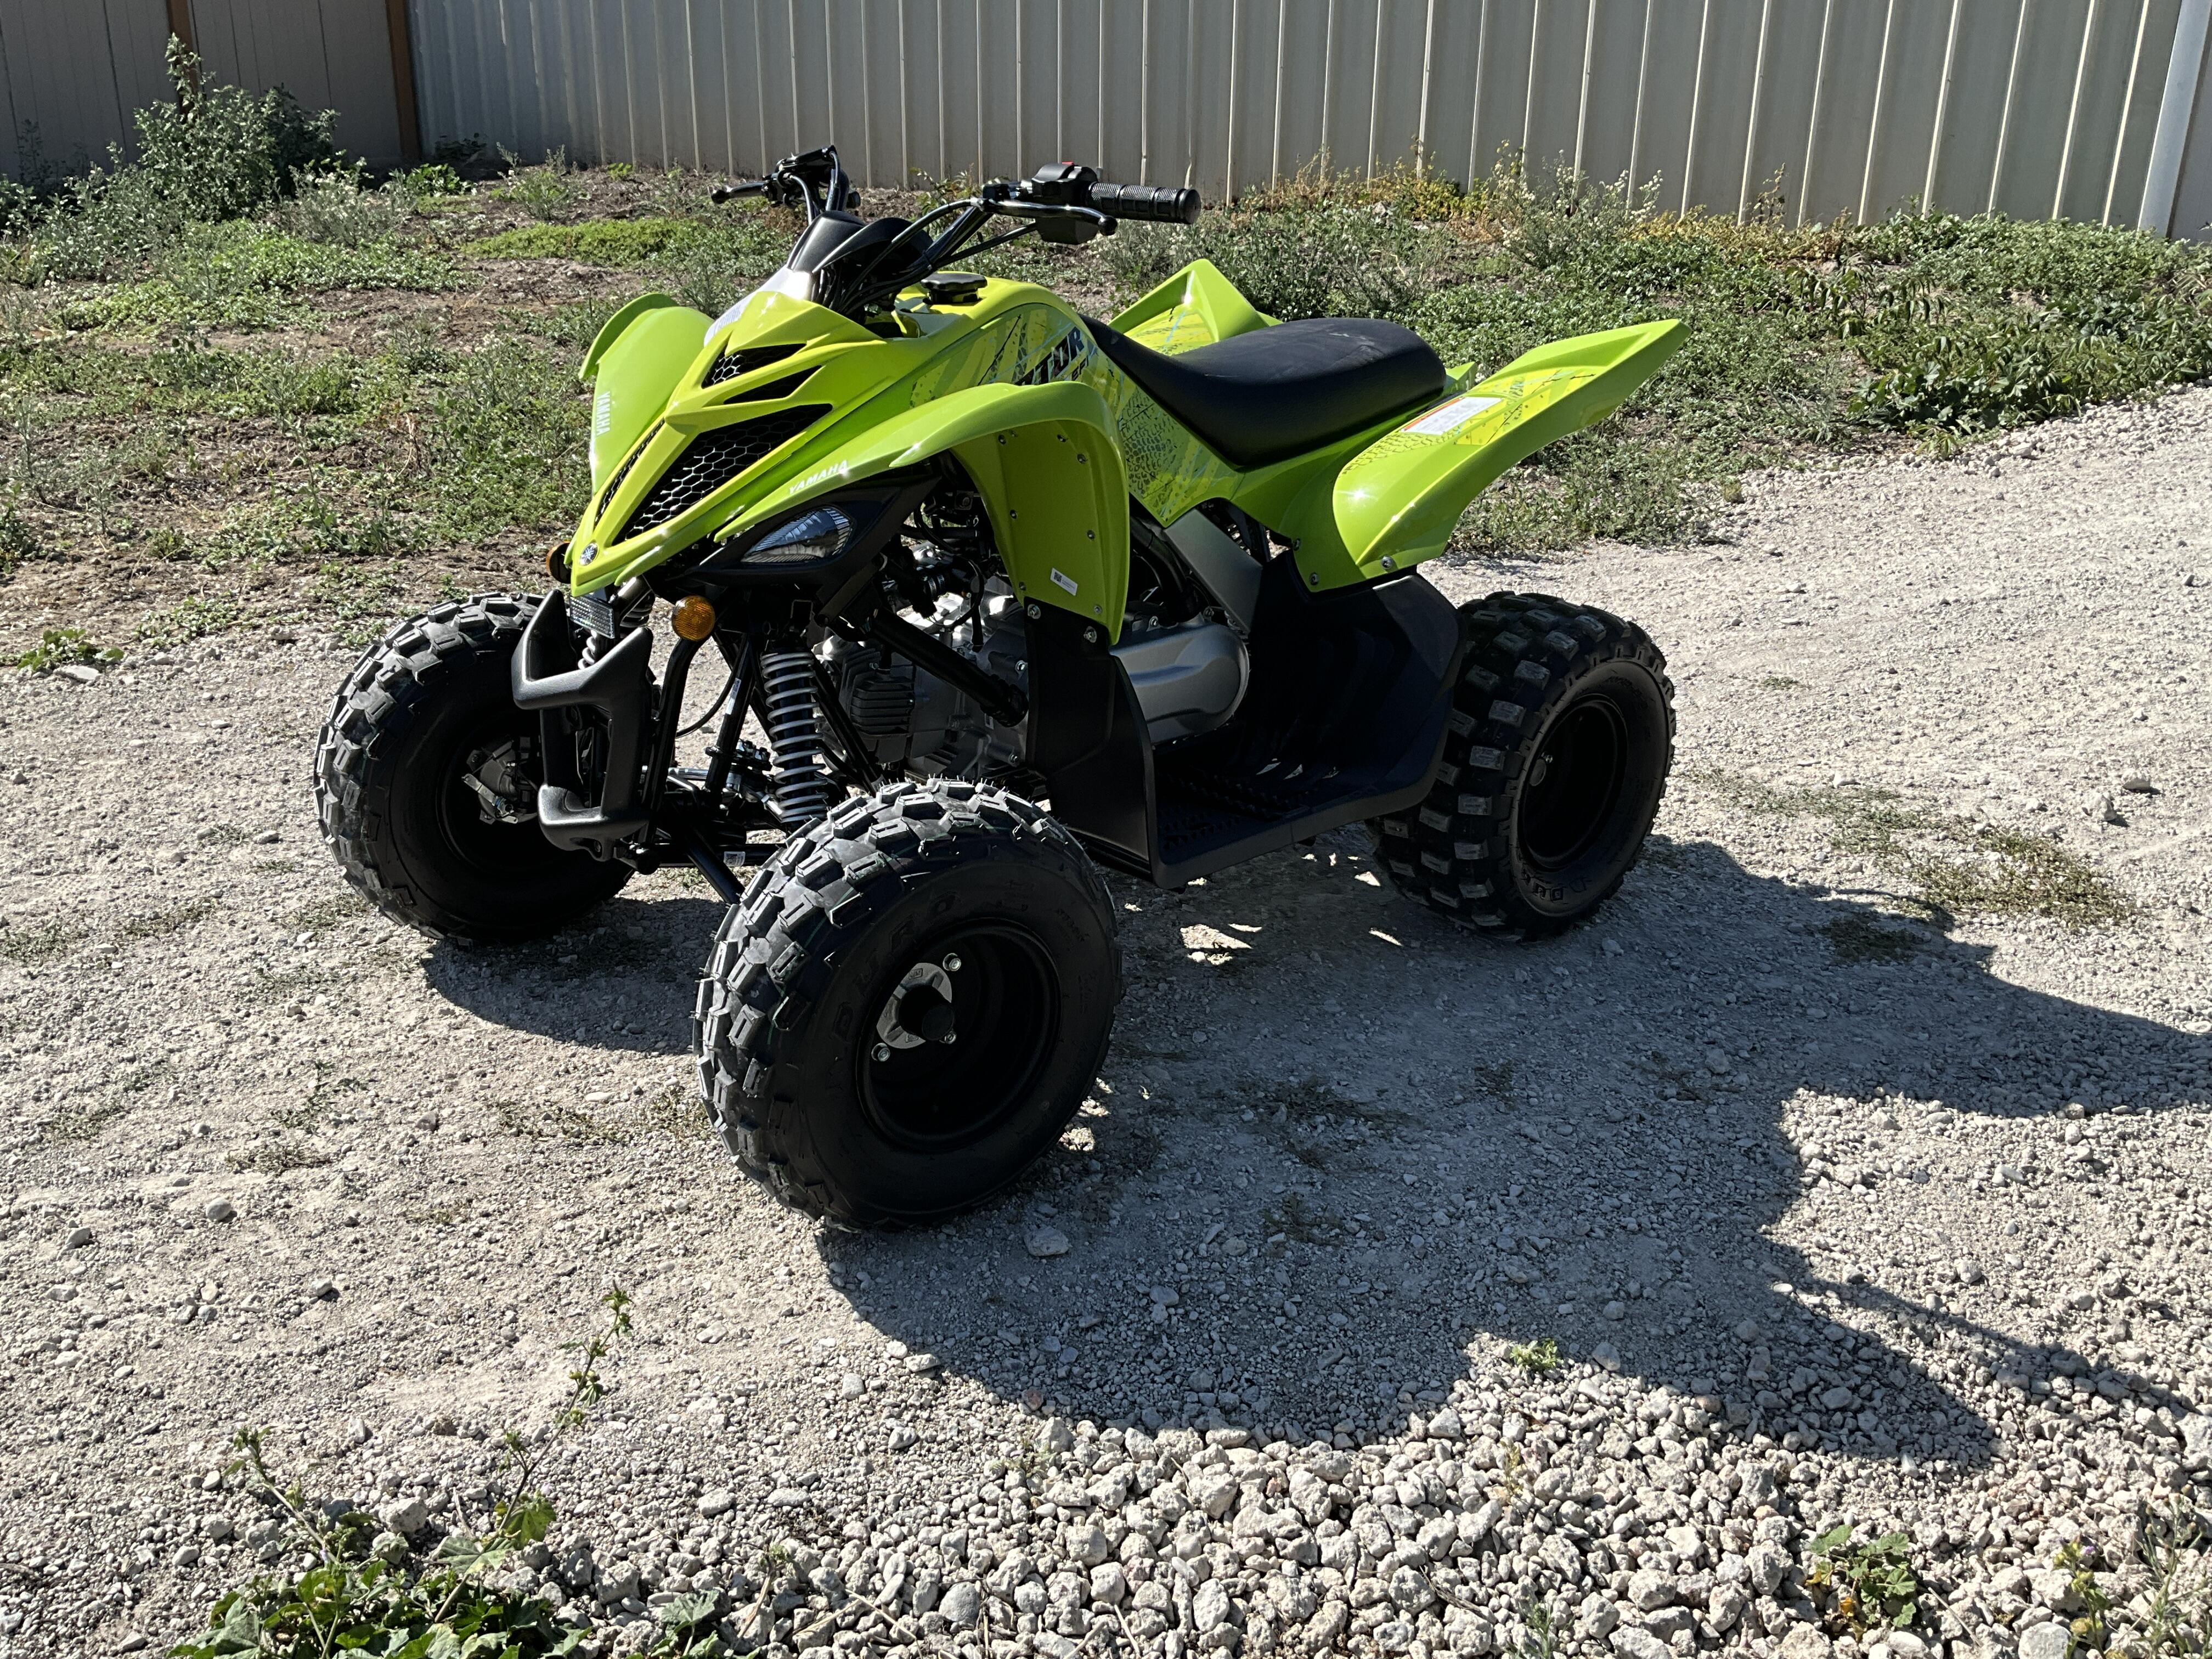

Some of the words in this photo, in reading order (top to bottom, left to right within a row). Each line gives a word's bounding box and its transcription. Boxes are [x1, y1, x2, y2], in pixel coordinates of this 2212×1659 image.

[1071, 354, 1090, 381] EFI
[596, 391, 611, 437] YAMAHA
[789, 459, 848, 495] YAMAHA
[833, 891, 959, 1039] DURO
